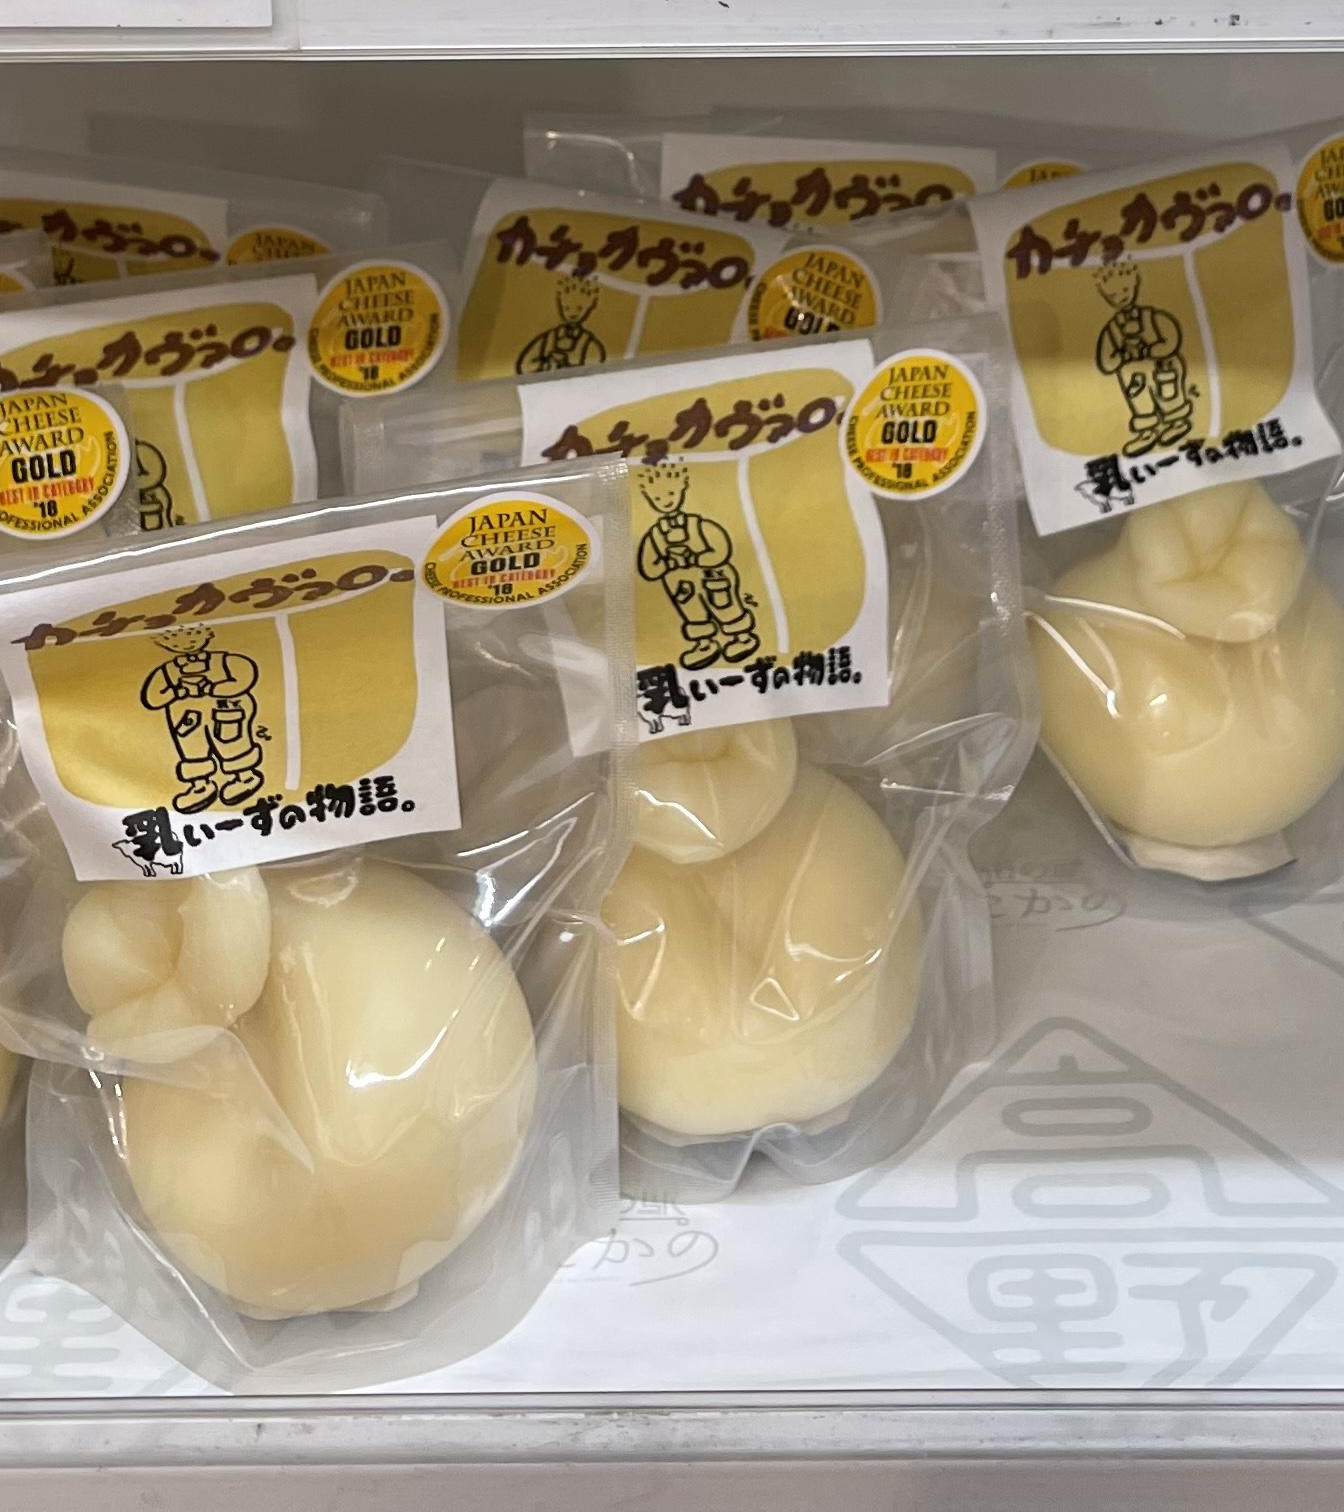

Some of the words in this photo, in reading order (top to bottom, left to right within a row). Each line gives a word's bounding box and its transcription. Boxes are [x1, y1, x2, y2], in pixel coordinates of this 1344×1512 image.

[346, 272, 406, 298] JAPAN
[345, 325, 401, 351] GOLD
[889, 364, 950, 385] JAPAN
[880, 382, 952, 401] CHEESE
[0, 393, 68, 420] JAPAN
[876, 401, 951, 419] AWARD
[881, 420, 937, 444] GOLD
[11, 449, 76, 484] GOLD
[469, 509, 547, 535] JAPAN
[461, 525, 556, 548] CHEESE
[459, 539, 555, 562] AWARD
[471, 552, 540, 575] GOLD
